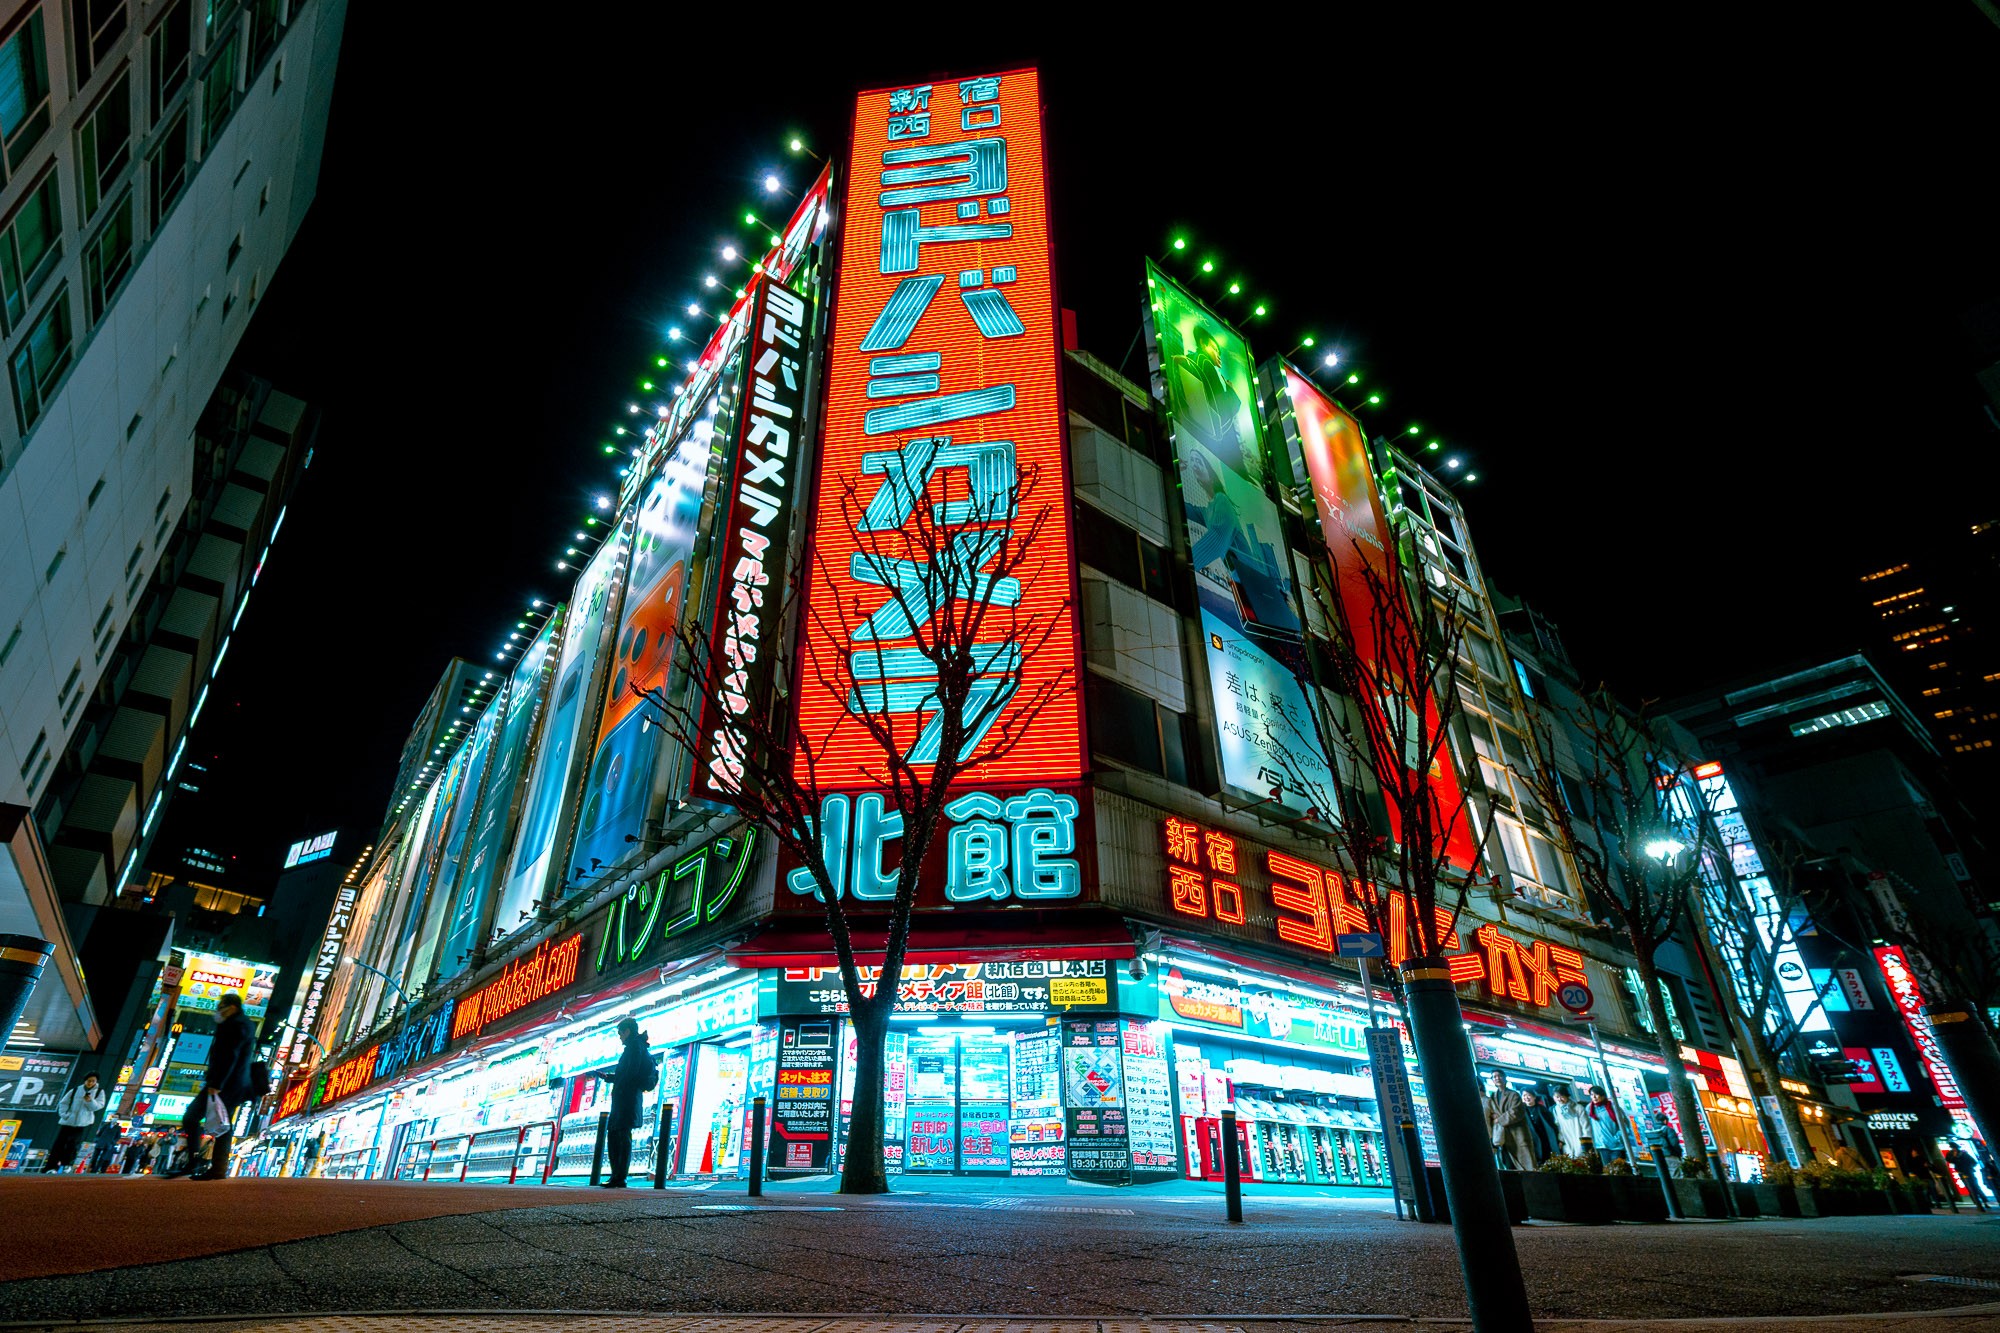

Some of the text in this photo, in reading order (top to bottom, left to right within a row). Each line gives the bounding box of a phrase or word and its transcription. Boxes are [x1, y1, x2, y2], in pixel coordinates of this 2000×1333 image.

[889, 77, 1001, 113] 新宿
[888, 104, 1001, 141] 西口
[739, 283, 804, 527] ヨドバシカメラ
[848, 137, 1027, 763] ヨドバシカメラ
[1226, 640, 1265, 666] Snapdragon
[1225, 670, 1307, 727] 差は、軽さ。
[1223, 720, 1325, 774] ASUS Zenbook SORA
[1256, 765, 1308, 798] ASUS
[301, 830, 338, 856] LABI
[786, 788, 1082, 903] 北館
[1165, 817, 1237, 876] 新宿
[596, 826, 757, 974] パソコン
[1168, 865, 1246, 926] 西口
[314, 888, 357, 981] ヨドバシカメラ
[985, 960, 1106, 979] 新宿西口本店
[1564, 989, 1586, 1005] 20
[1845, 971, 1867, 1009] カラオケ
[1123, 1031, 1156, 1056] 買取
[780, 1071, 831, 1083] ネットで注文
[1879, 1049, 1903, 1090] カラオケ
[779, 1087, 829, 1098] 店舗で受取り
[1867, 1121, 1911, 1130] COFFEE
[910, 1136, 954, 1155] 新しい
[1010, 1146, 1066, 1161] いらっしゃいませ
